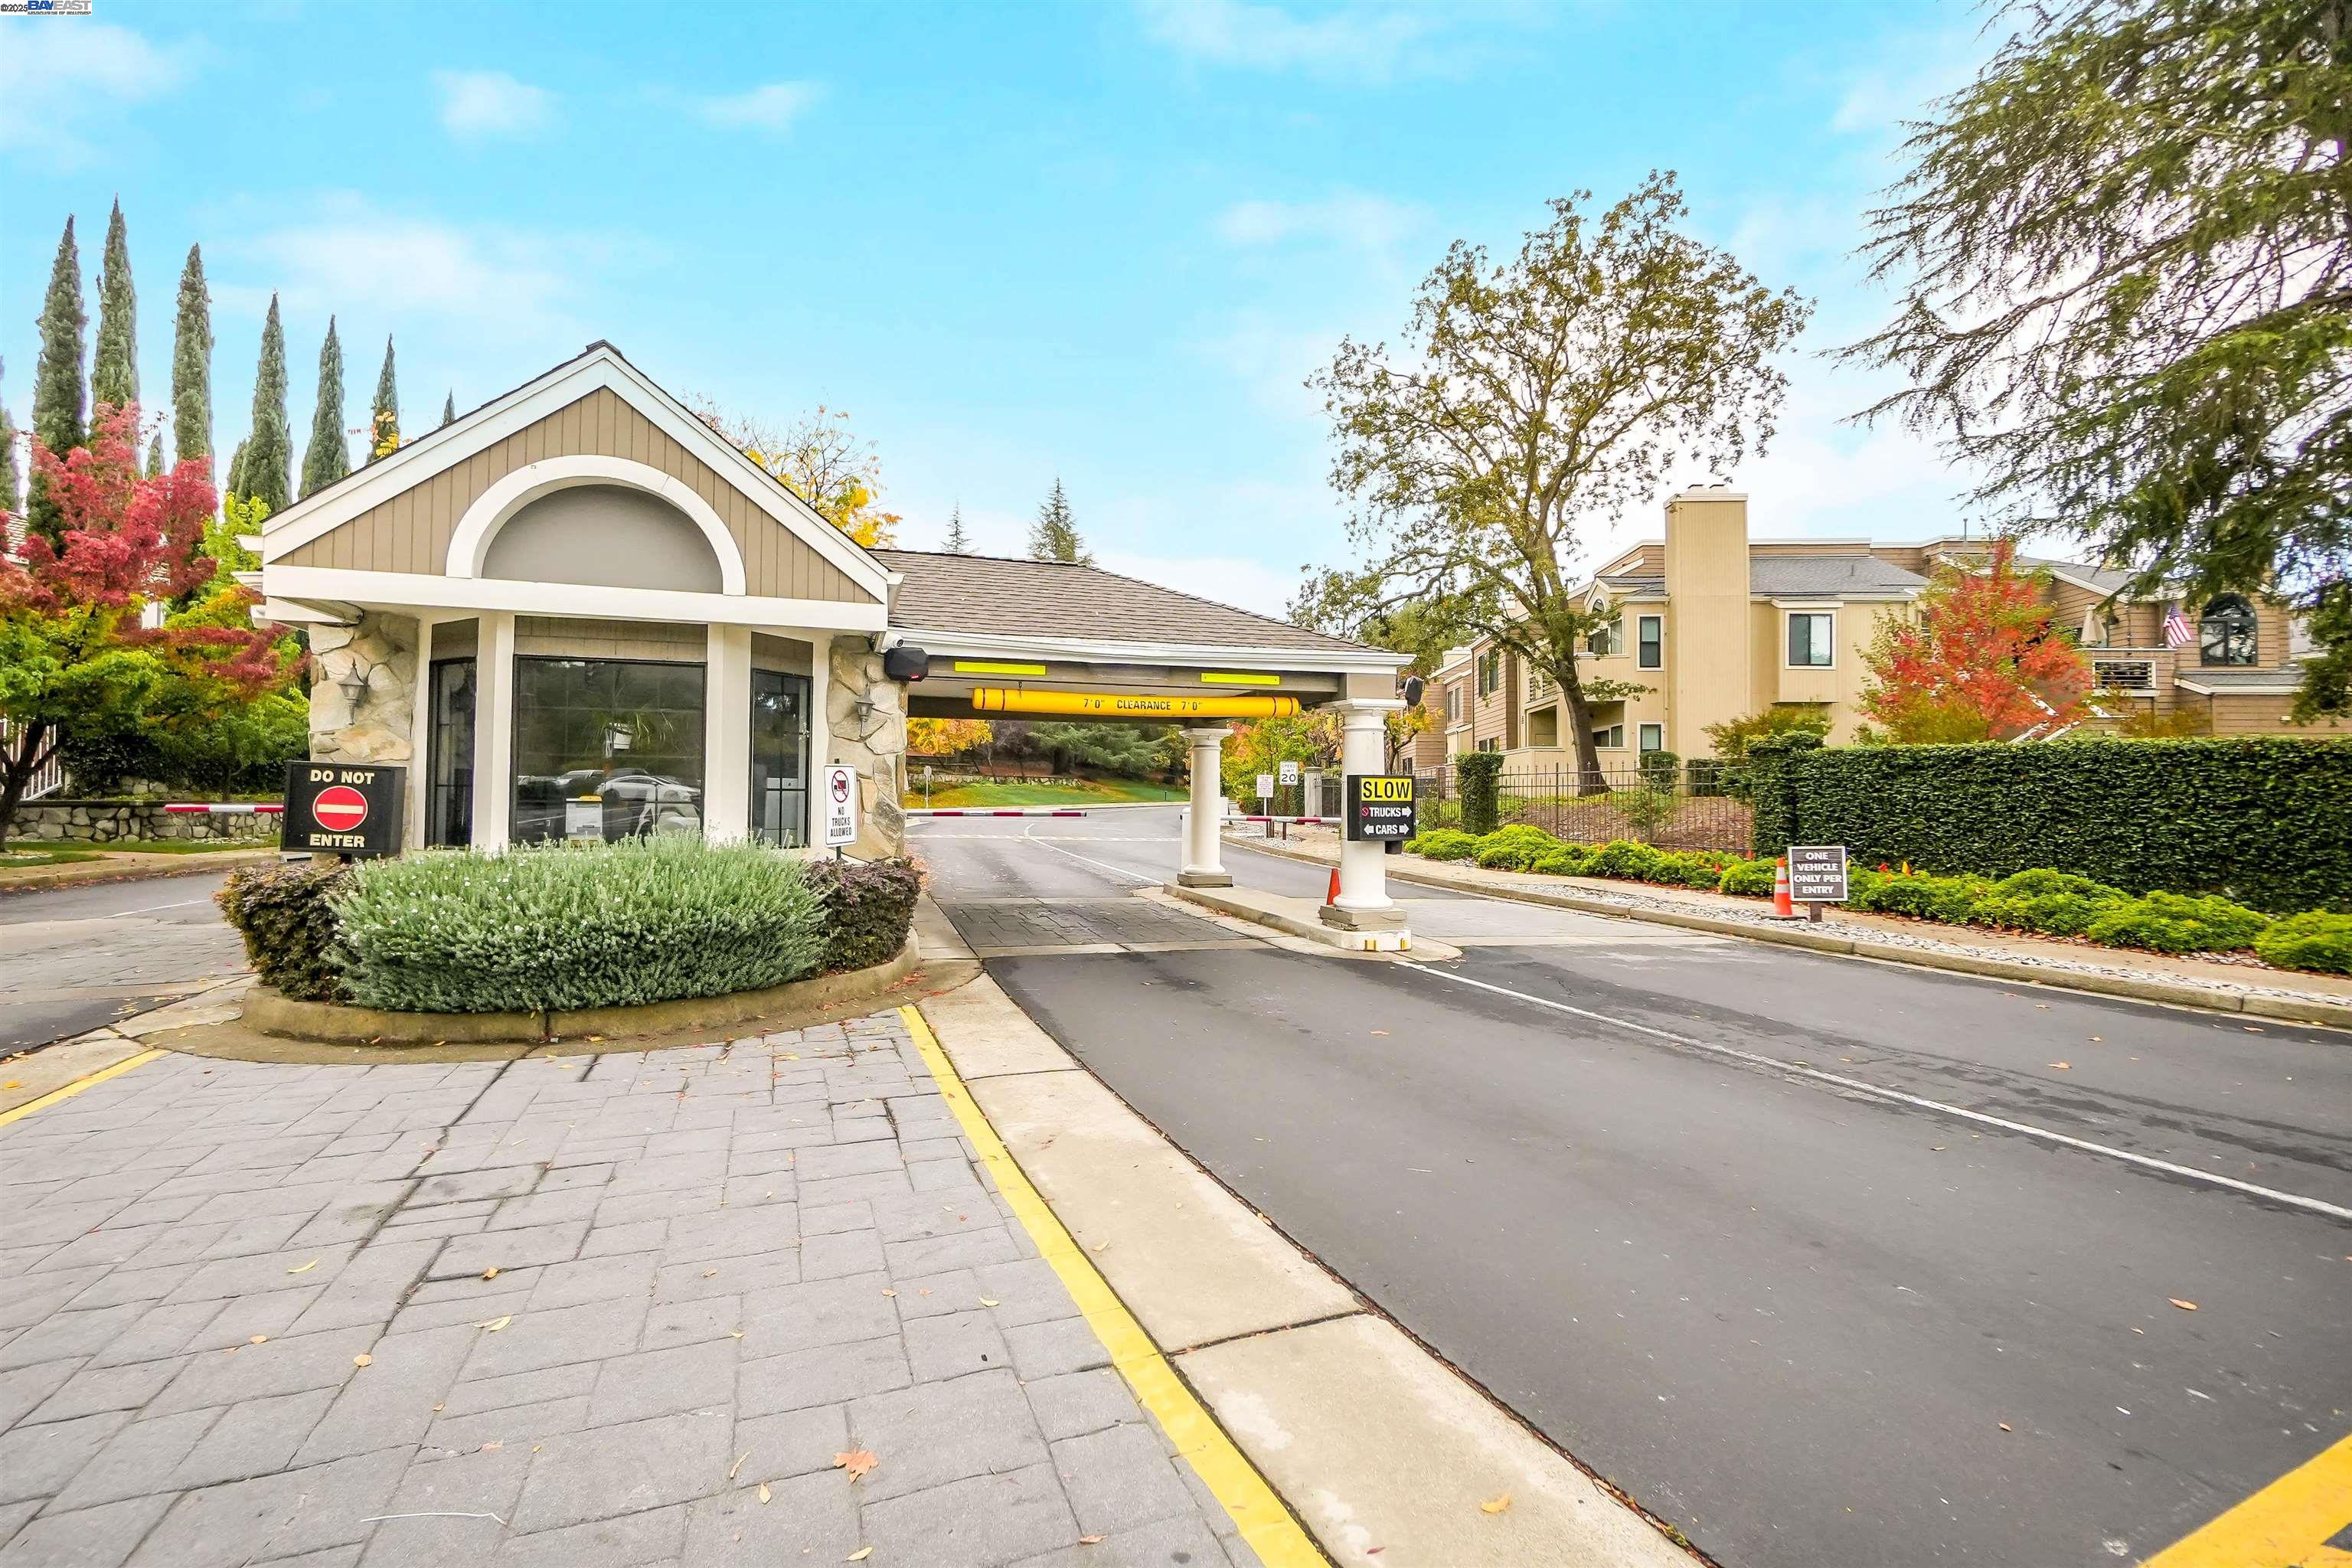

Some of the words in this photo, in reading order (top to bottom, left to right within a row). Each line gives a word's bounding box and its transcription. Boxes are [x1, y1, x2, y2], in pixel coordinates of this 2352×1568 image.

[1117, 701, 1171, 710] CLEARANCE
[310, 769, 334, 782] DO
[341, 772, 374, 784] NOT
[1363, 781, 1410, 798] SLOW
[1370, 808, 1401, 817] TRUCKS
[832, 817, 851, 826] TRUCKS
[831, 828, 851, 837] ALLOWED
[1376, 825, 1397, 835] CARS
[310, 834, 365, 848] ENTER
